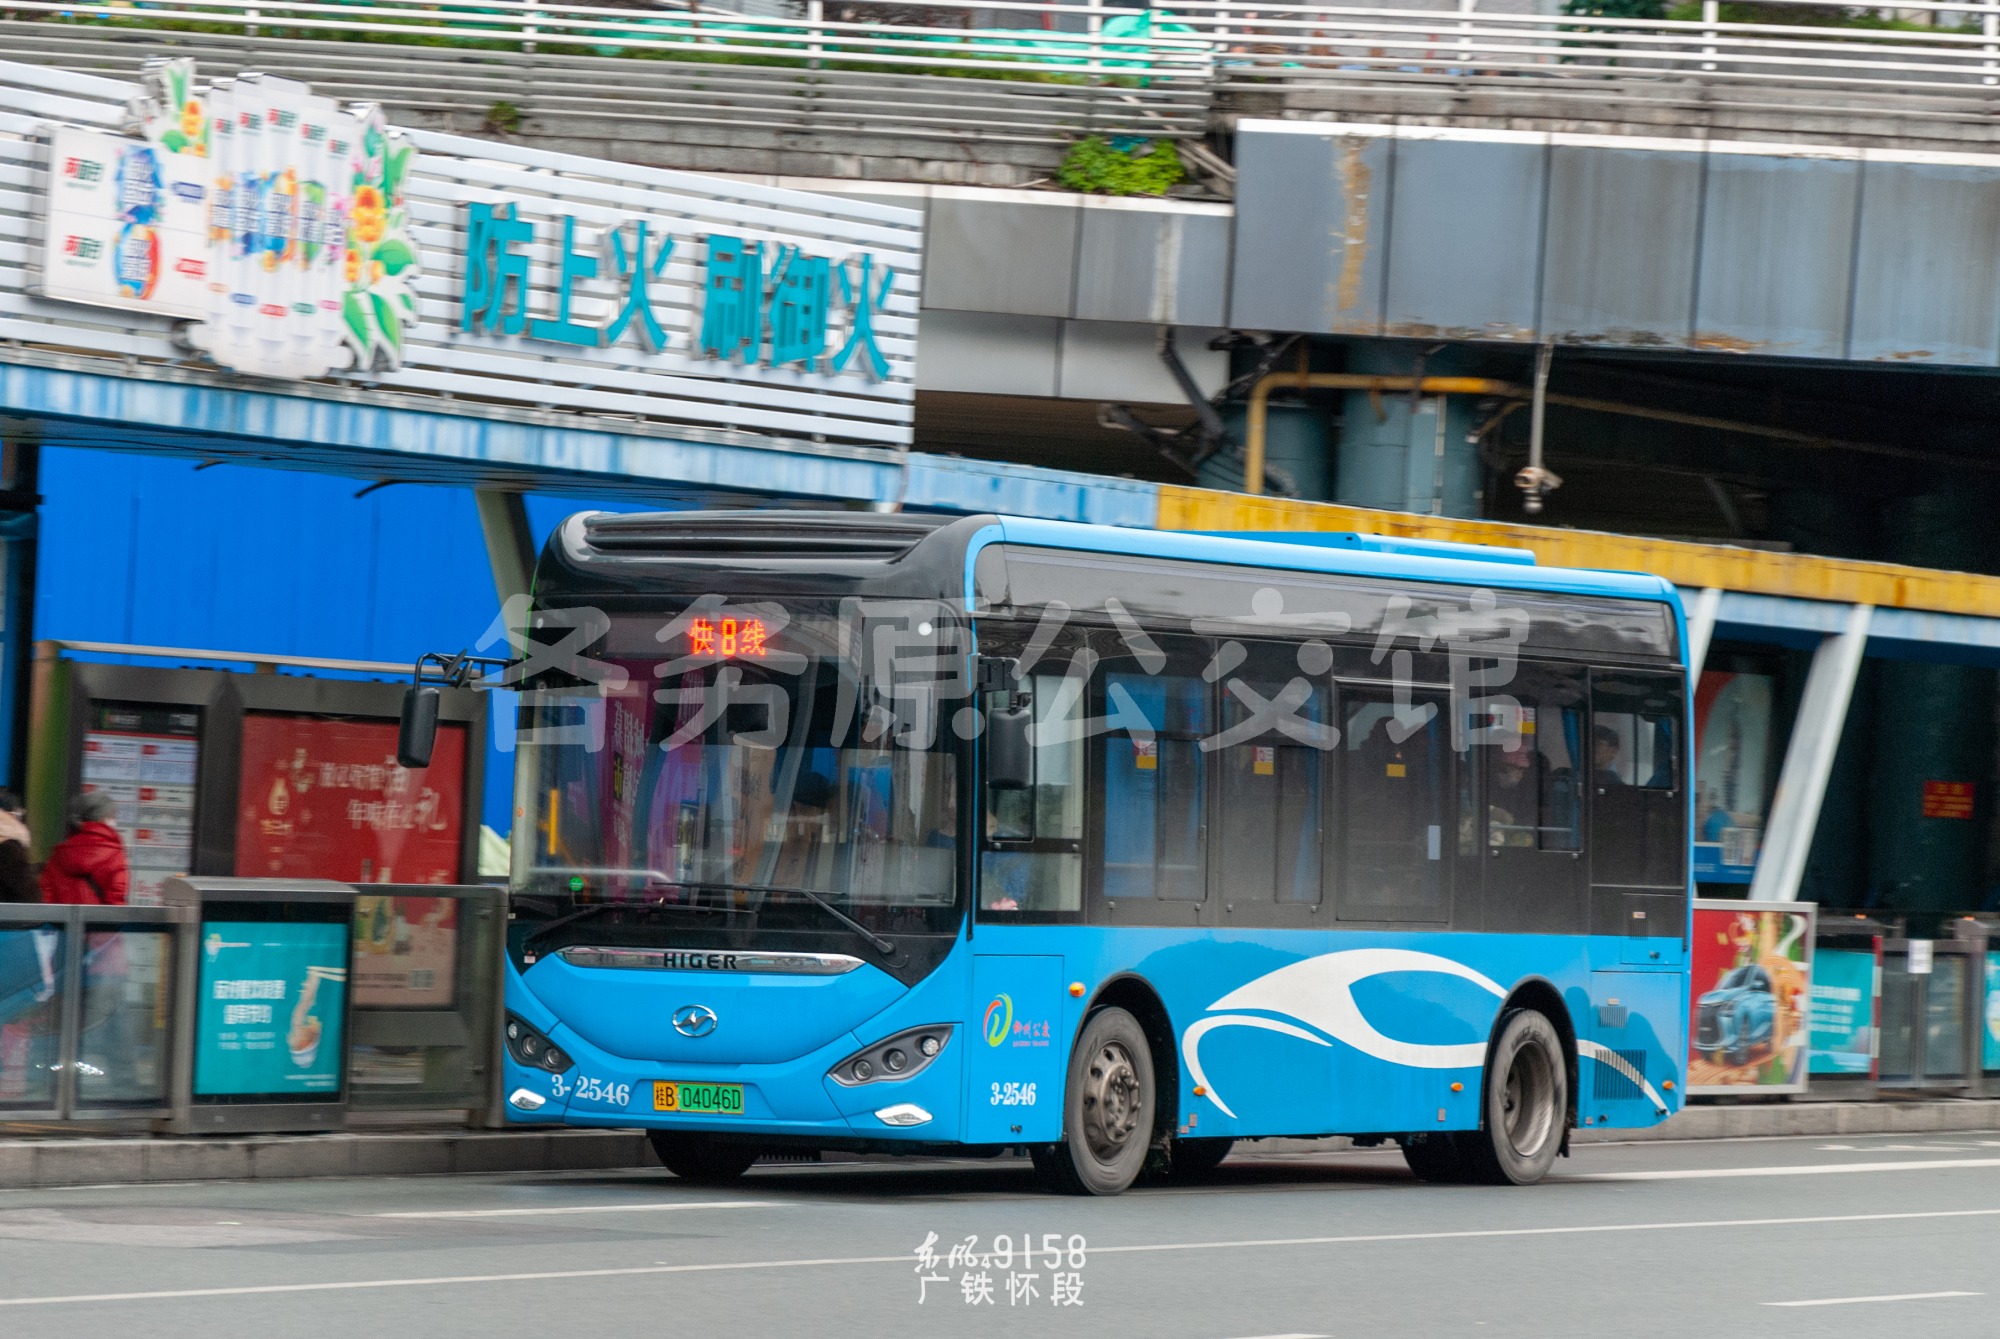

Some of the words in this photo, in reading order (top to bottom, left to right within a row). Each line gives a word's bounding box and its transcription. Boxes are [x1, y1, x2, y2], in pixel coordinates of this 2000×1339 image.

[459, 200, 675, 354] 防上火
[689, 617, 767, 656] 快8线
[663, 951, 738, 971] HIGER
[990, 1082, 1037, 1107] 3-2546
